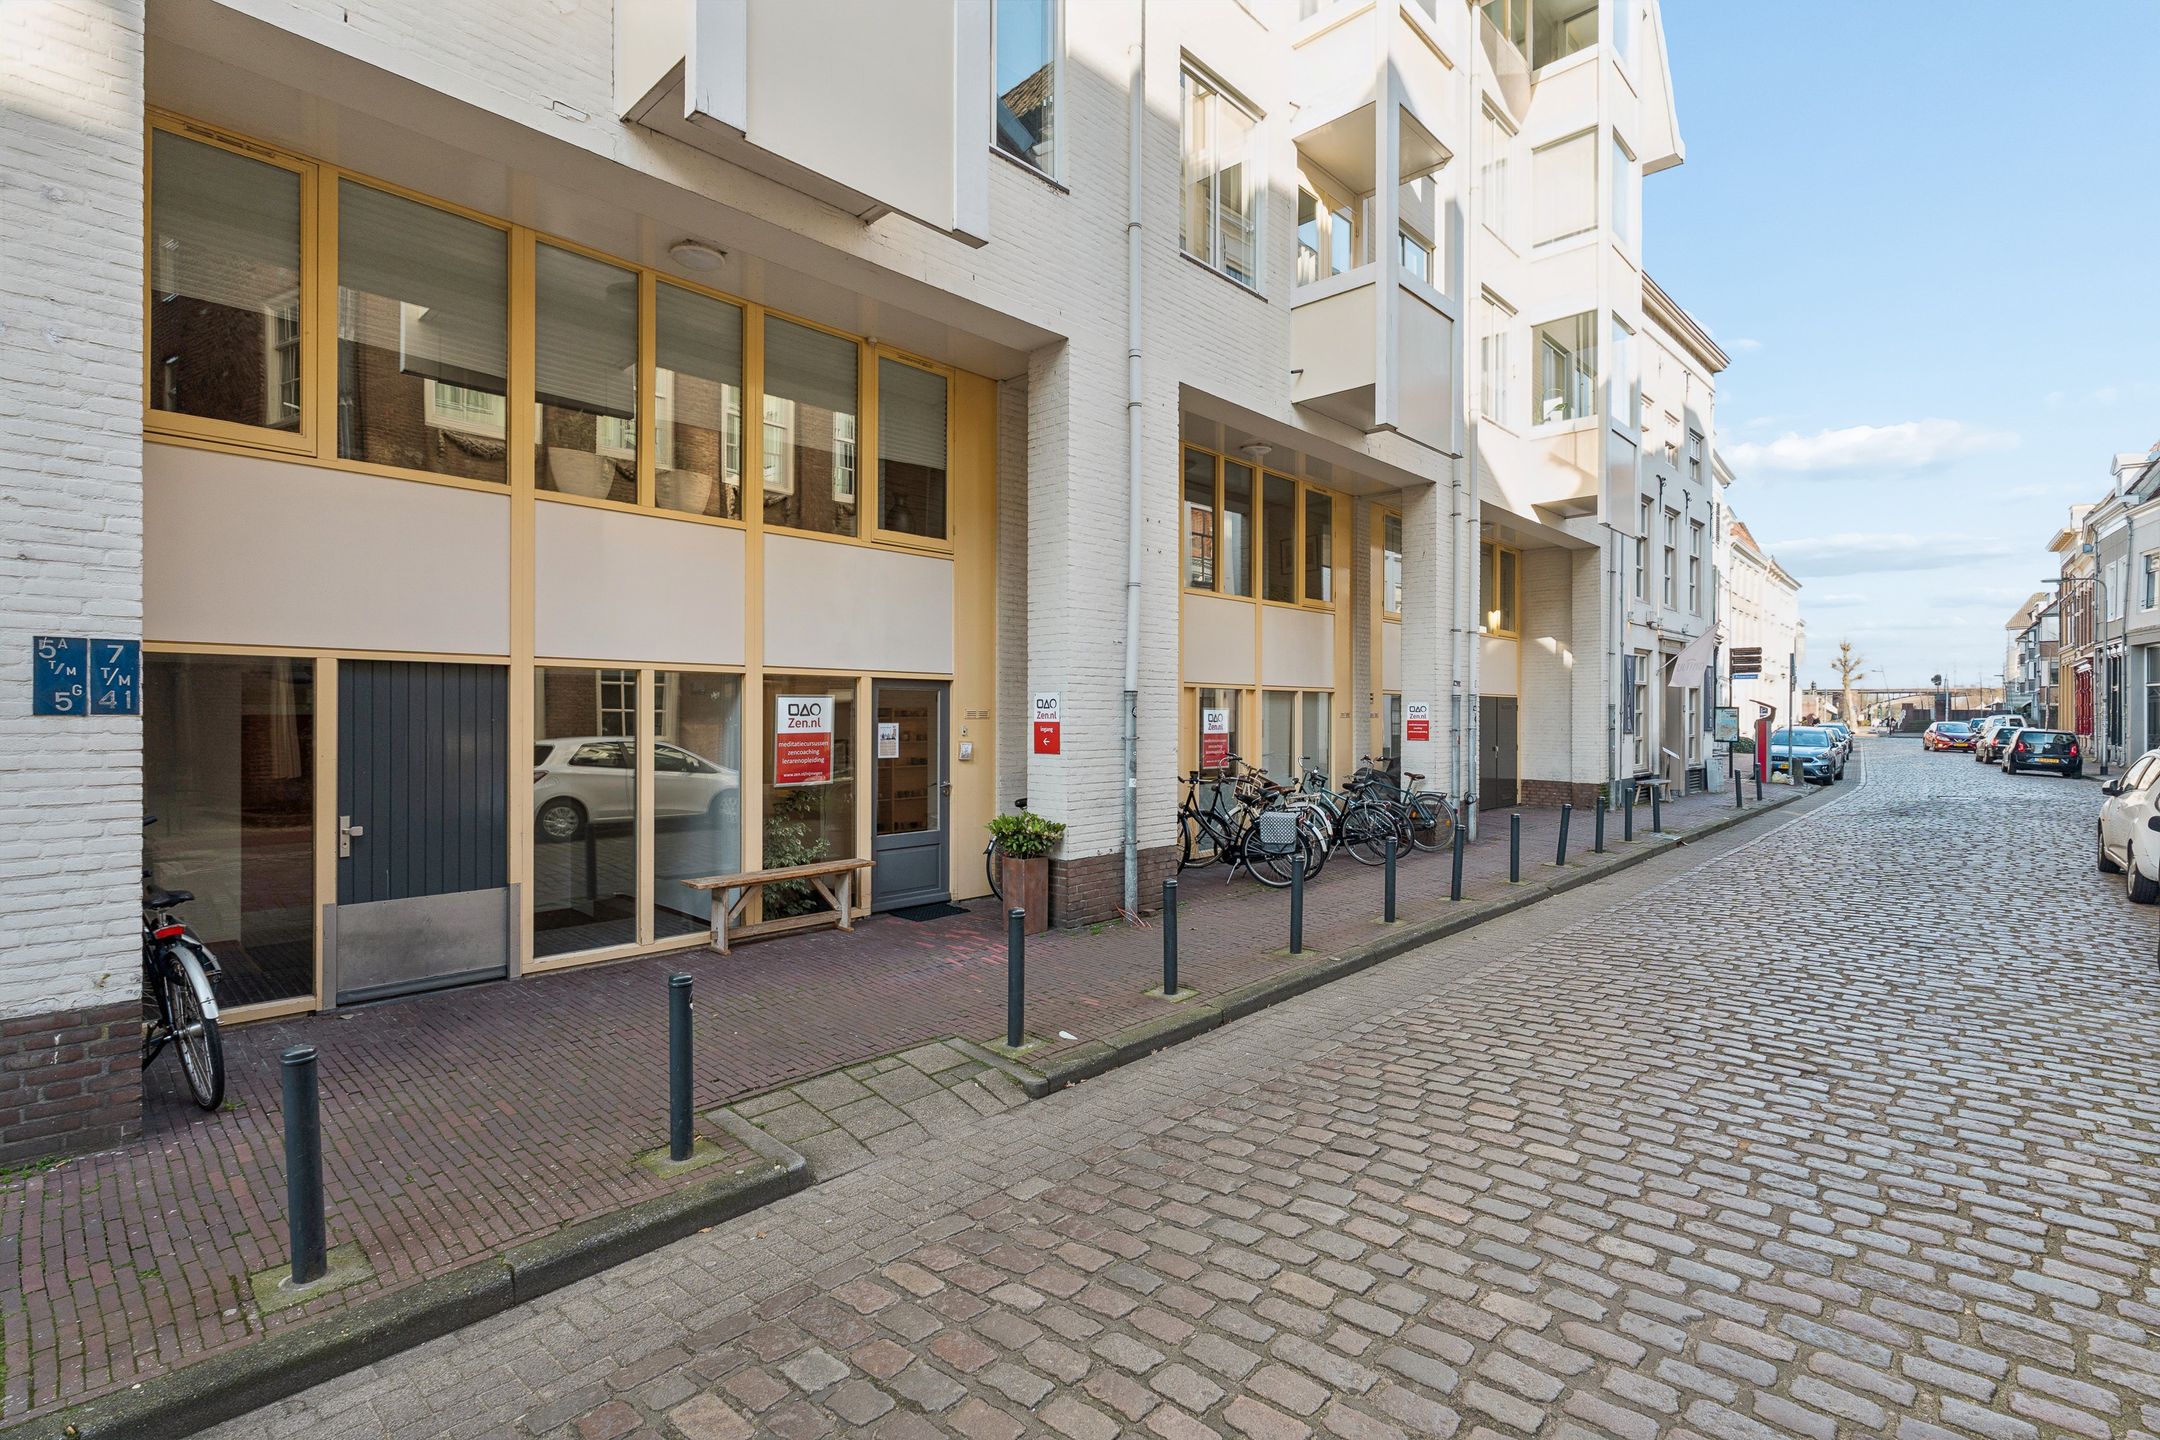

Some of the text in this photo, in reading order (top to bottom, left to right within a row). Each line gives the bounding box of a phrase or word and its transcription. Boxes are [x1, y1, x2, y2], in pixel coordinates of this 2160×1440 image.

[106, 644, 124, 664] 7
[100, 667, 131, 686] T/M
[98, 690, 131, 709] 41
[1036, 711, 1057, 720] Zen.nl
[787, 718, 822, 729] Zen.nl
[1207, 723, 1224, 731] Zen.nl
[782, 757, 825, 765] lerarenopleiding
